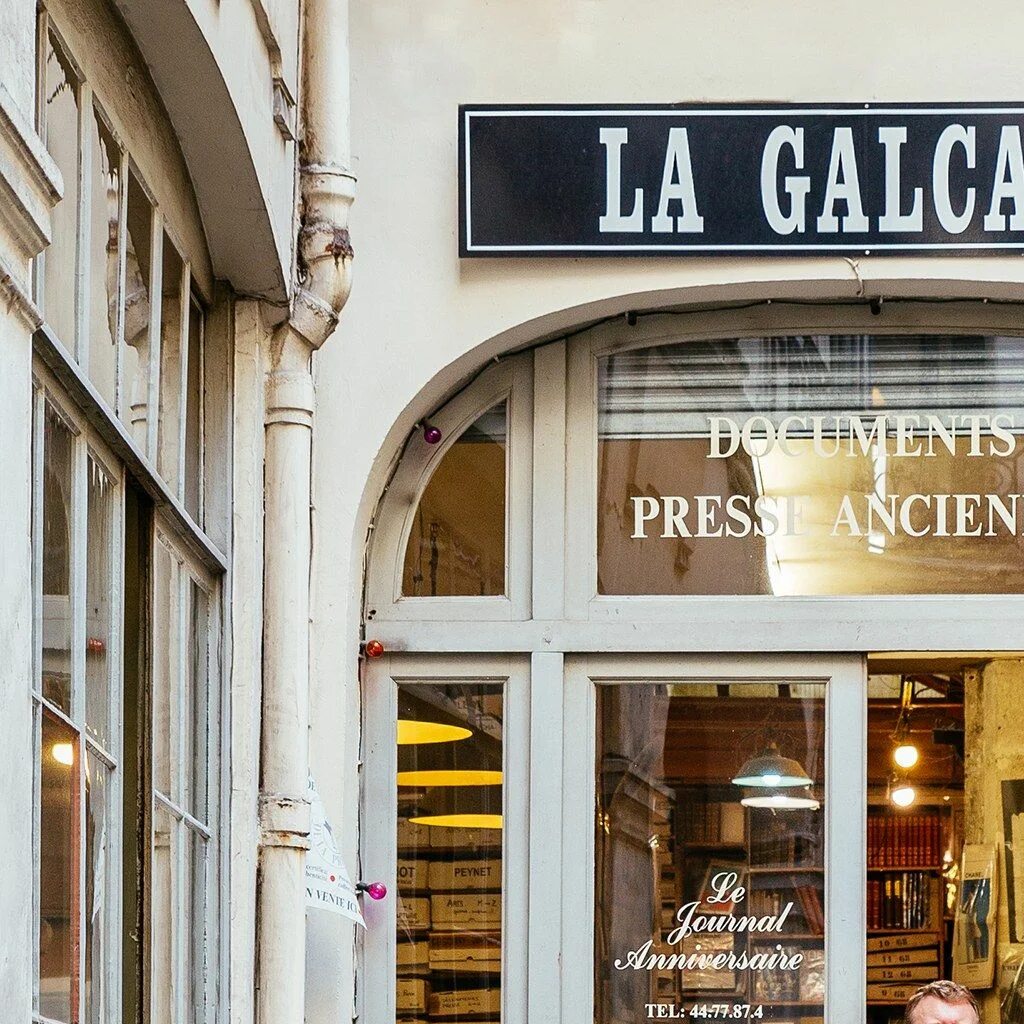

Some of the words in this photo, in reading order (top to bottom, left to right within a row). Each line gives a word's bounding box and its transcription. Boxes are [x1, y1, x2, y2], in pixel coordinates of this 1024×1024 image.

[599, 127, 704, 233] LA
[705, 413, 1017, 459] DOCUMENTS
[454, 867, 492, 877] PEYNET
[707, 872, 746, 904] Le
[667, 901, 794, 946] Journal
[614, 938, 804, 971] Anniversaire
[645, 1004, 685, 1019] TEL:
[689, 1004, 764, 1019] 44.77.87.4
